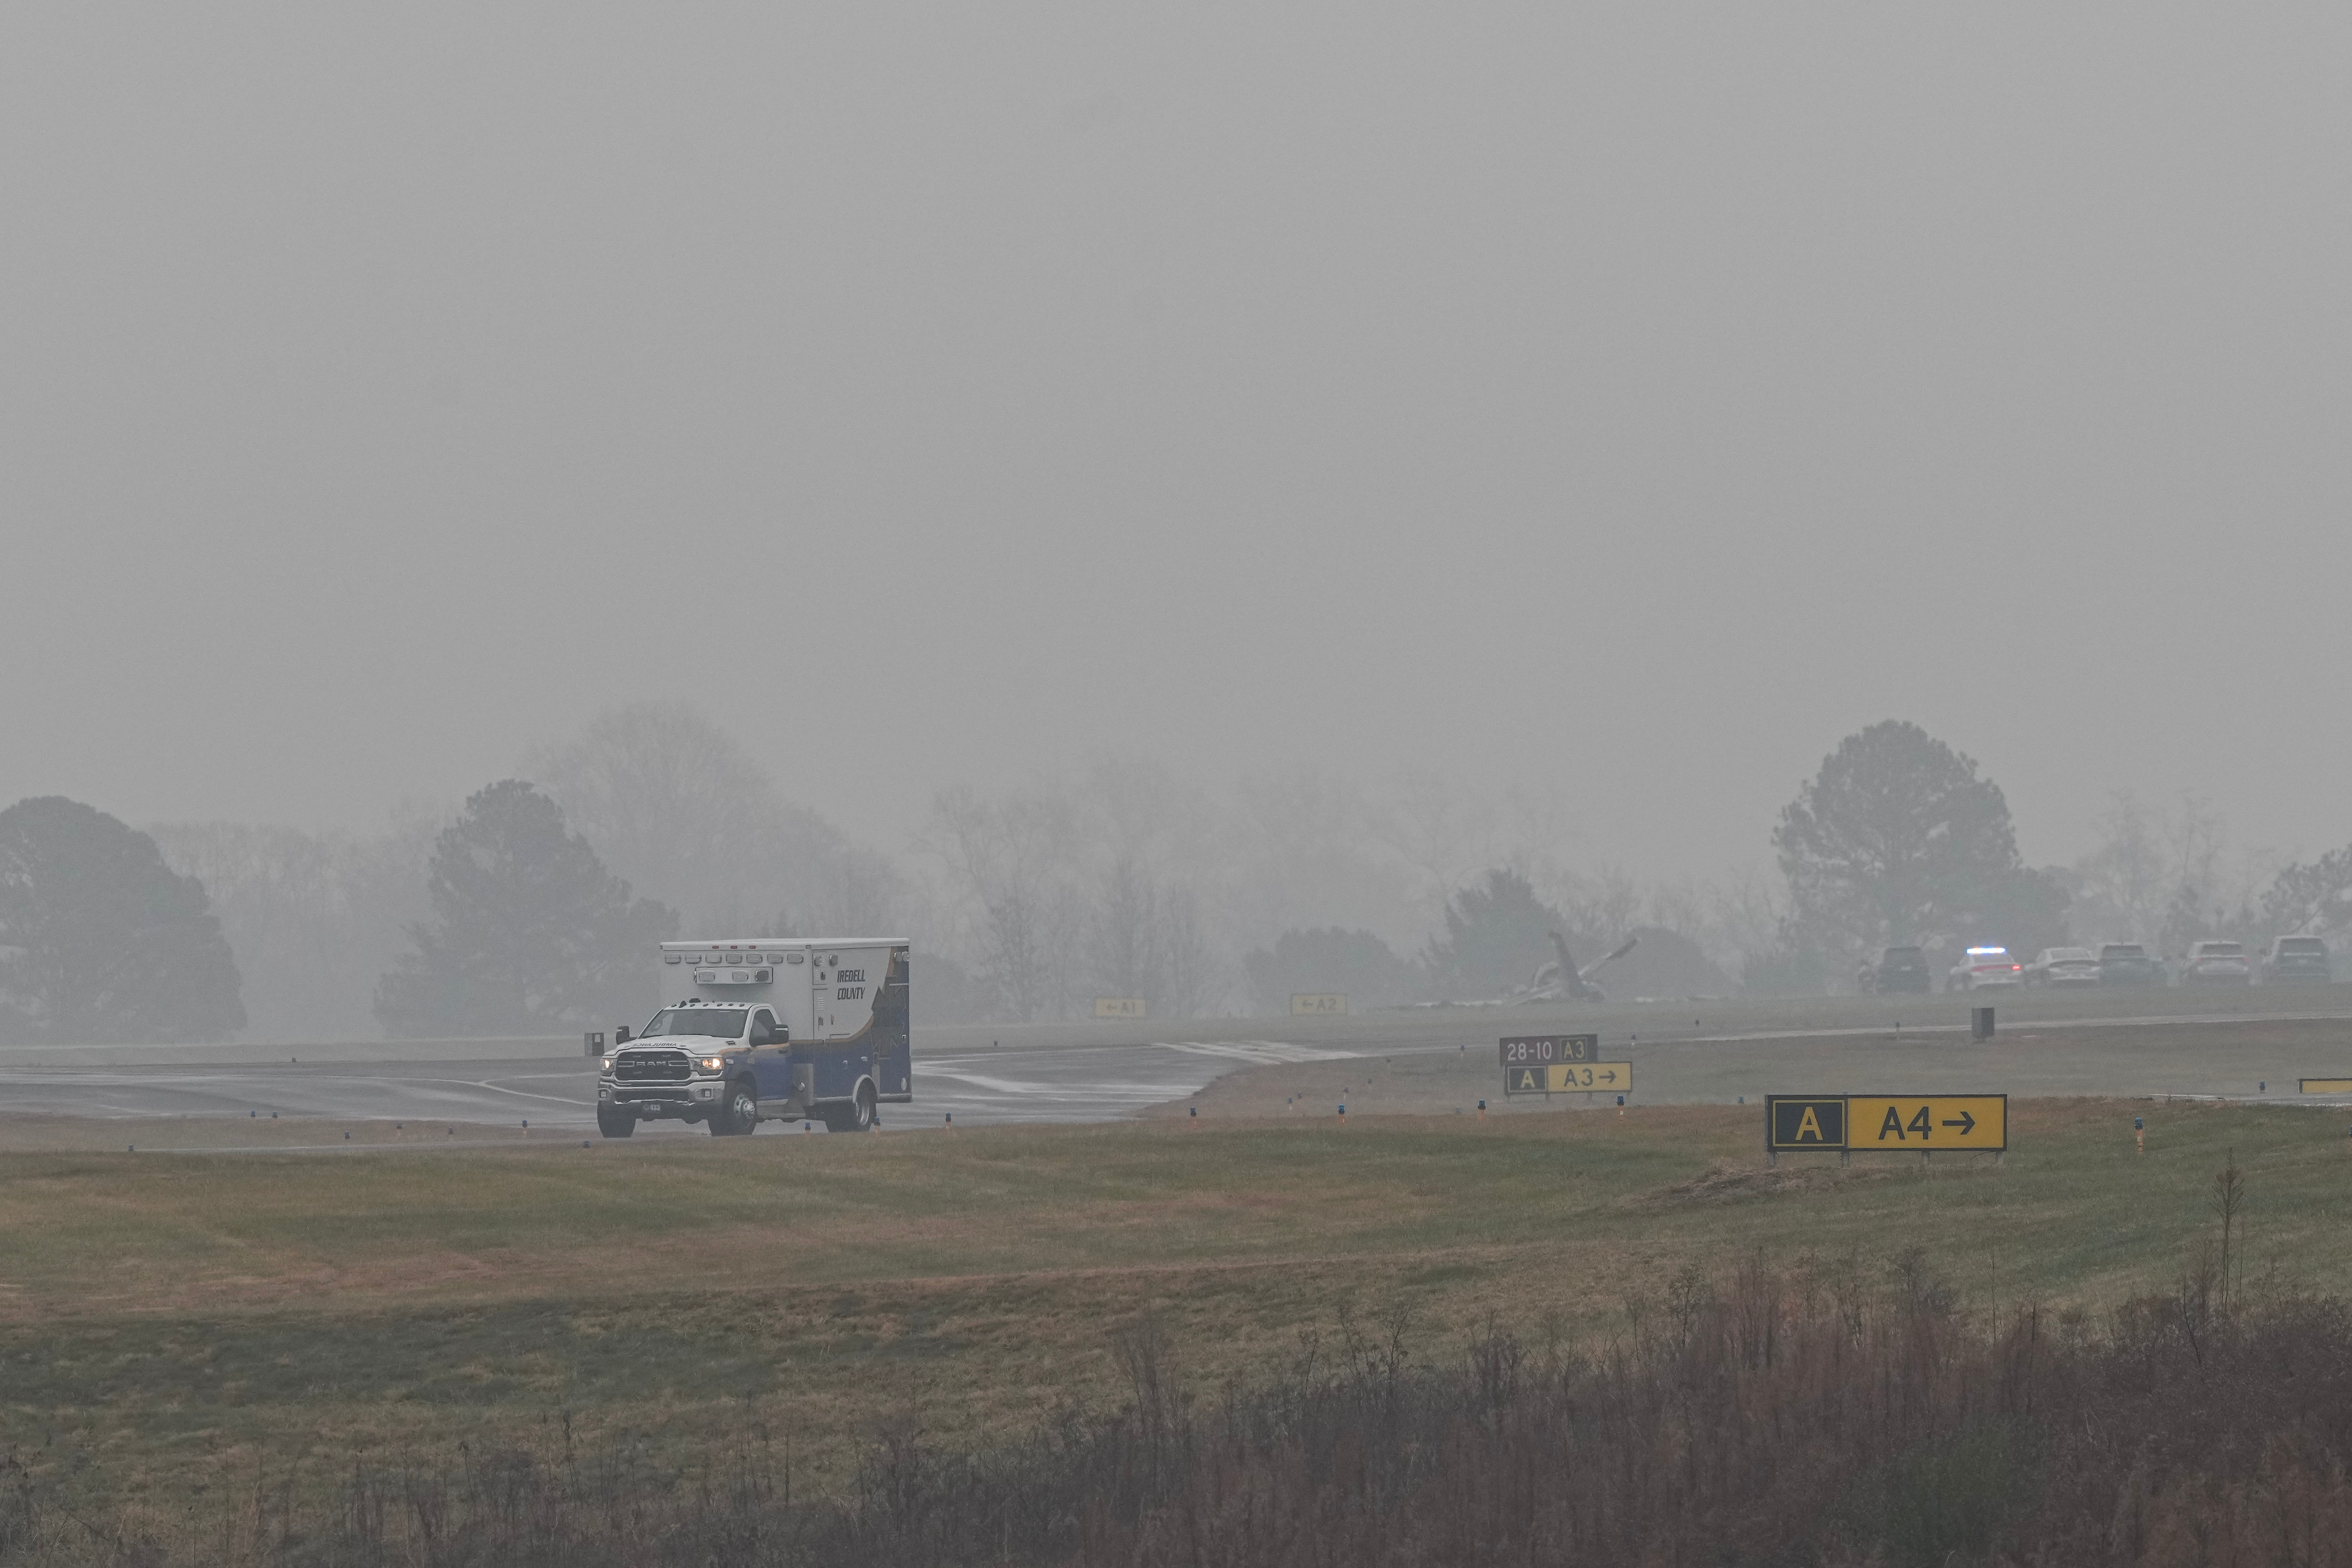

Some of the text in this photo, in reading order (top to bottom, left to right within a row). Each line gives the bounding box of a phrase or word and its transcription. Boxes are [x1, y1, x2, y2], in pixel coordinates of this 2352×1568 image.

[837, 969, 866, 983] IREDELL
[837, 987, 866, 1000] COUNTY
[1121, 1002, 1136, 1014] A1
[1317, 998, 1337, 1011] A2
[1507, 1041, 1584, 1061] 28-10 A3
[1520, 1068, 1593, 1089] A A3
[1795, 1106, 1932, 1141] A A4
